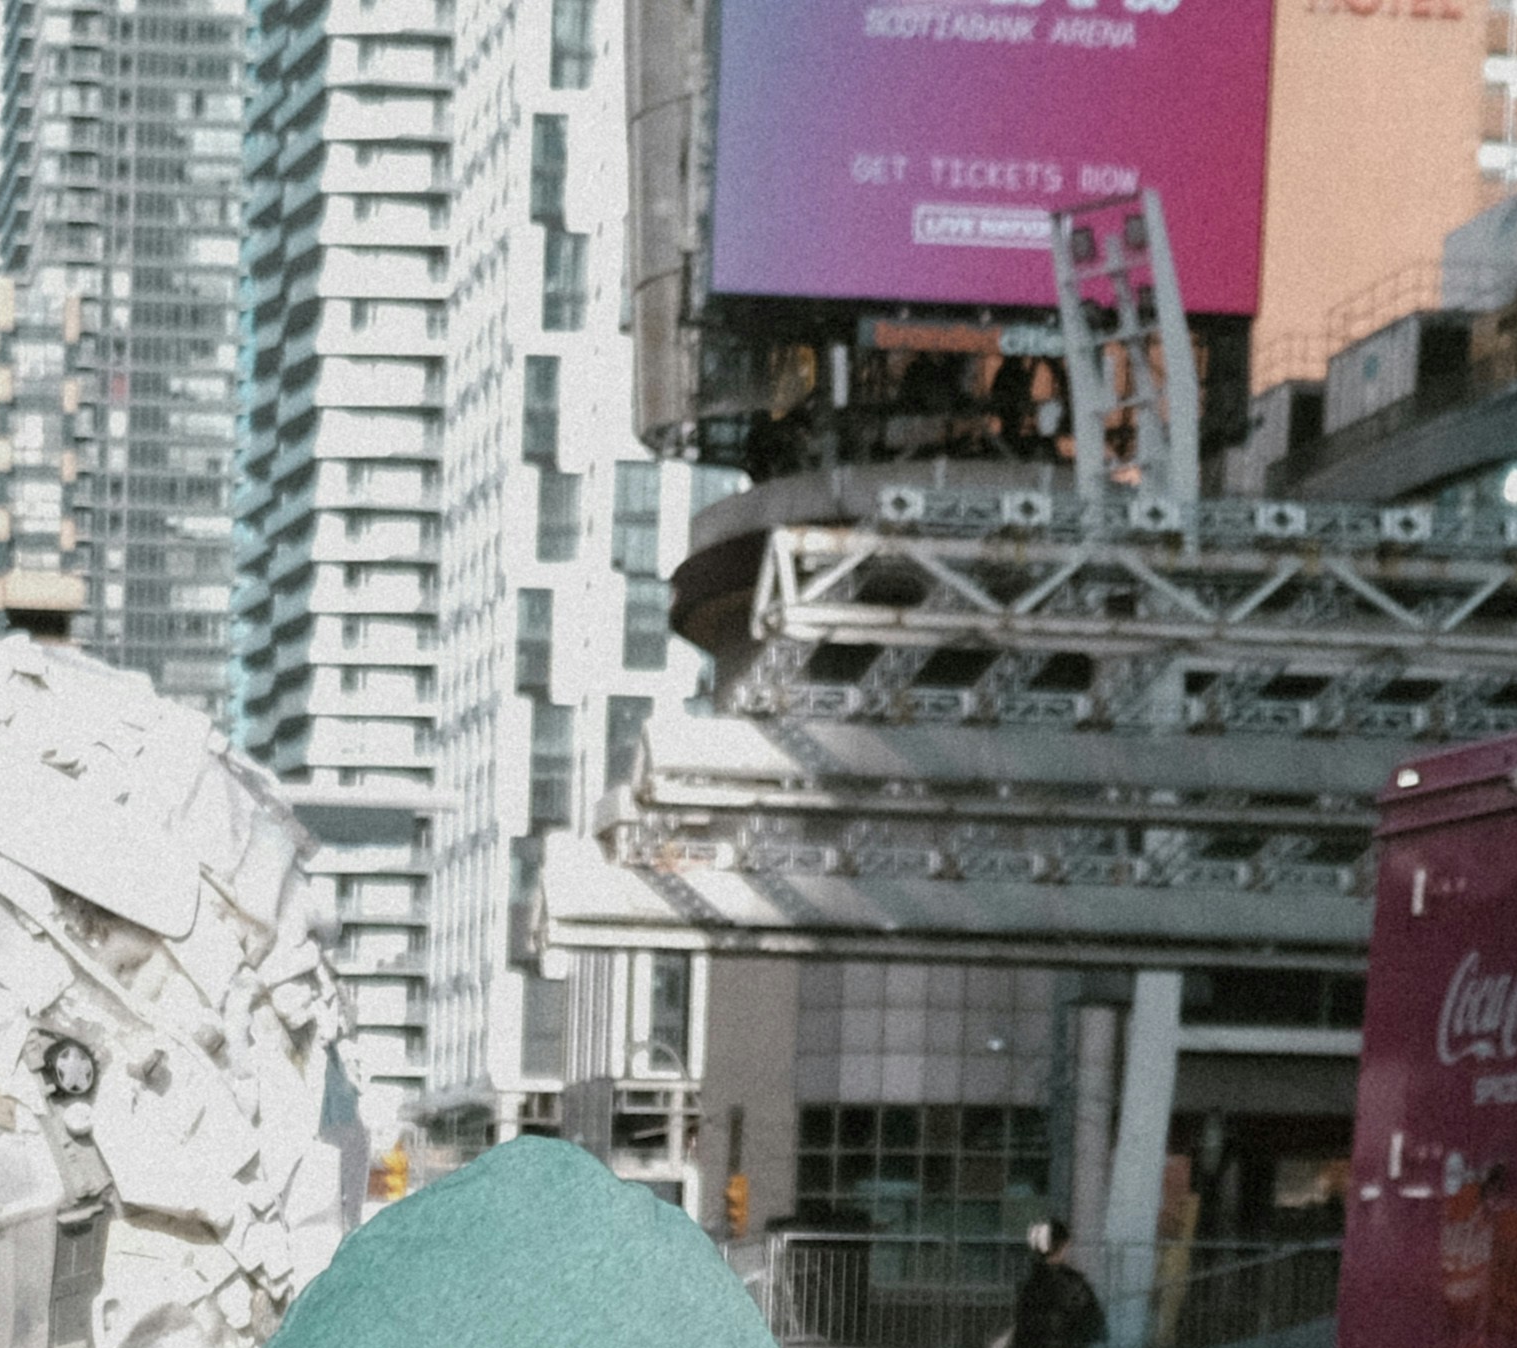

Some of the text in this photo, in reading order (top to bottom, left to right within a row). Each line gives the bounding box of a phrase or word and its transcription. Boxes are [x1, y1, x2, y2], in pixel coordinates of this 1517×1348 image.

[851, 154, 1141, 195] GET TICKETS NOW
